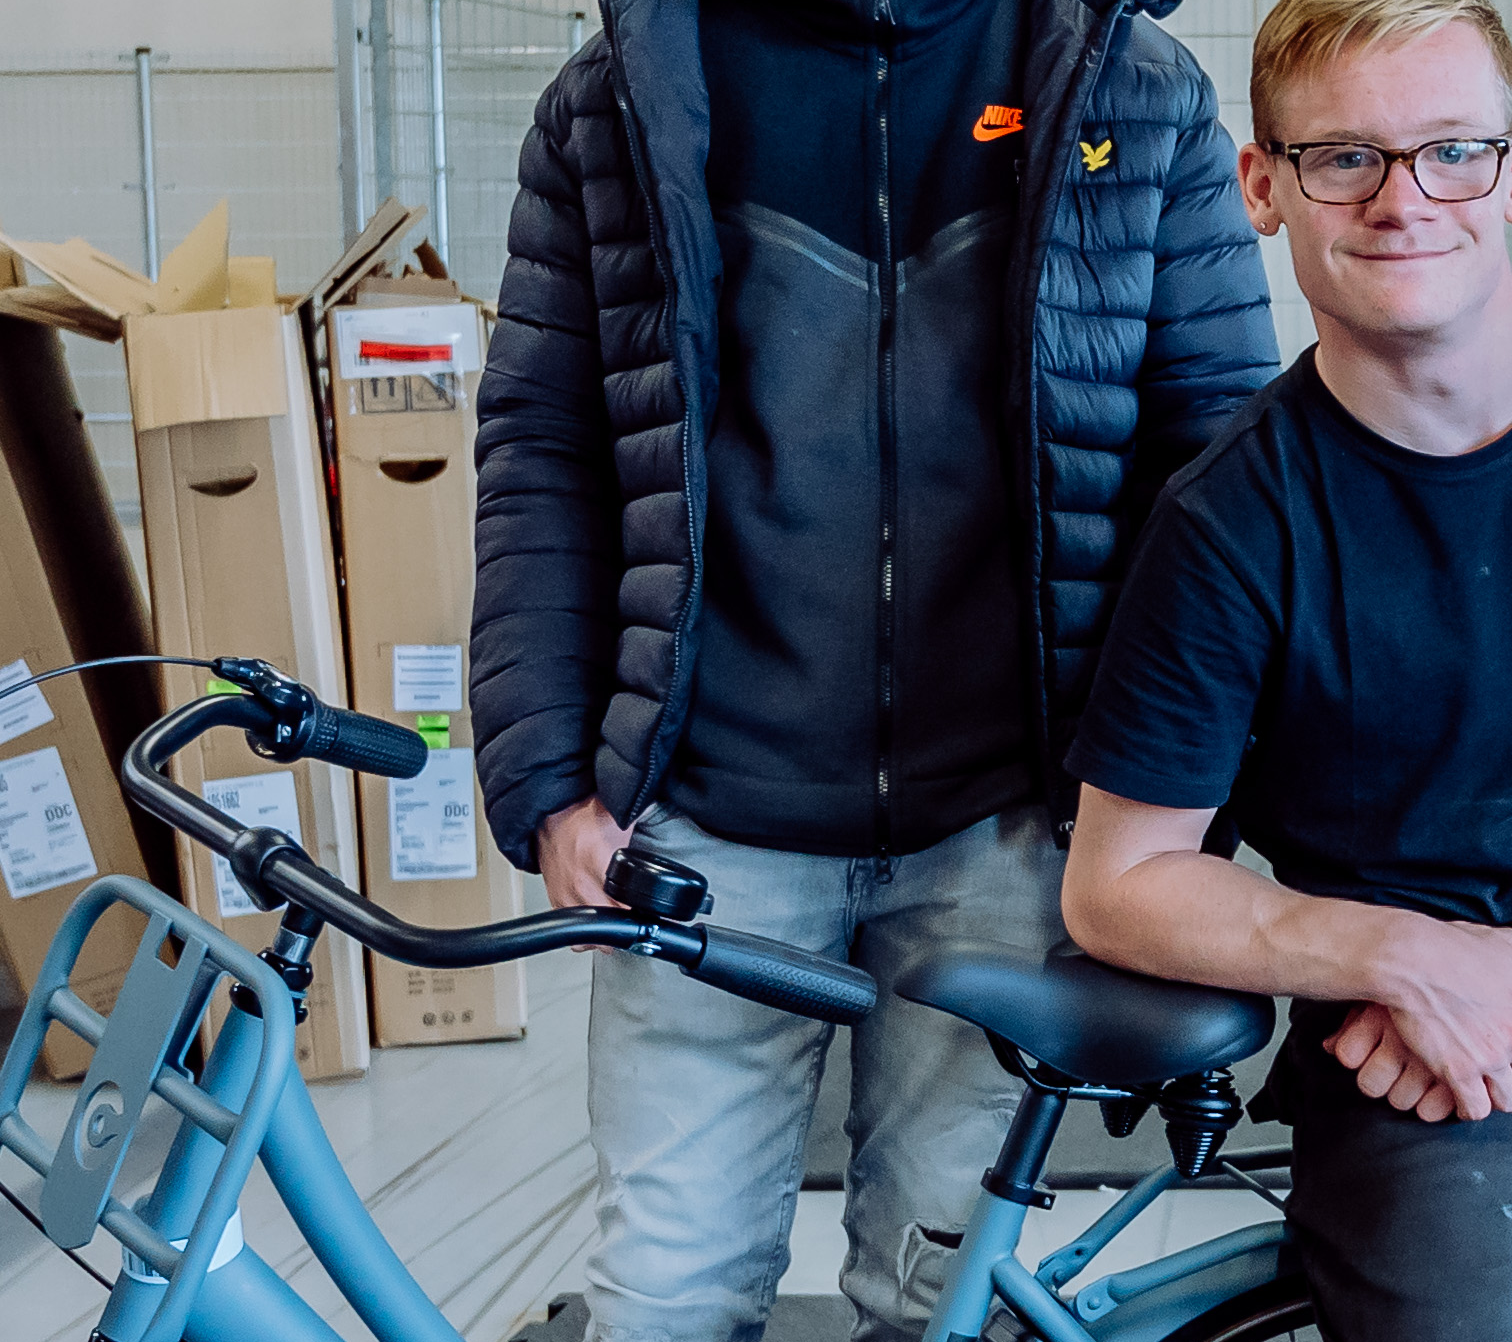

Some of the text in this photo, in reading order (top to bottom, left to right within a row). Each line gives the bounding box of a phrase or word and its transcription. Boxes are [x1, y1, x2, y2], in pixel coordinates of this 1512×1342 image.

[982, 105, 1023, 126] NIKE
[43, 804, 73, 822] DDC
[444, 804, 470, 818] DDC
